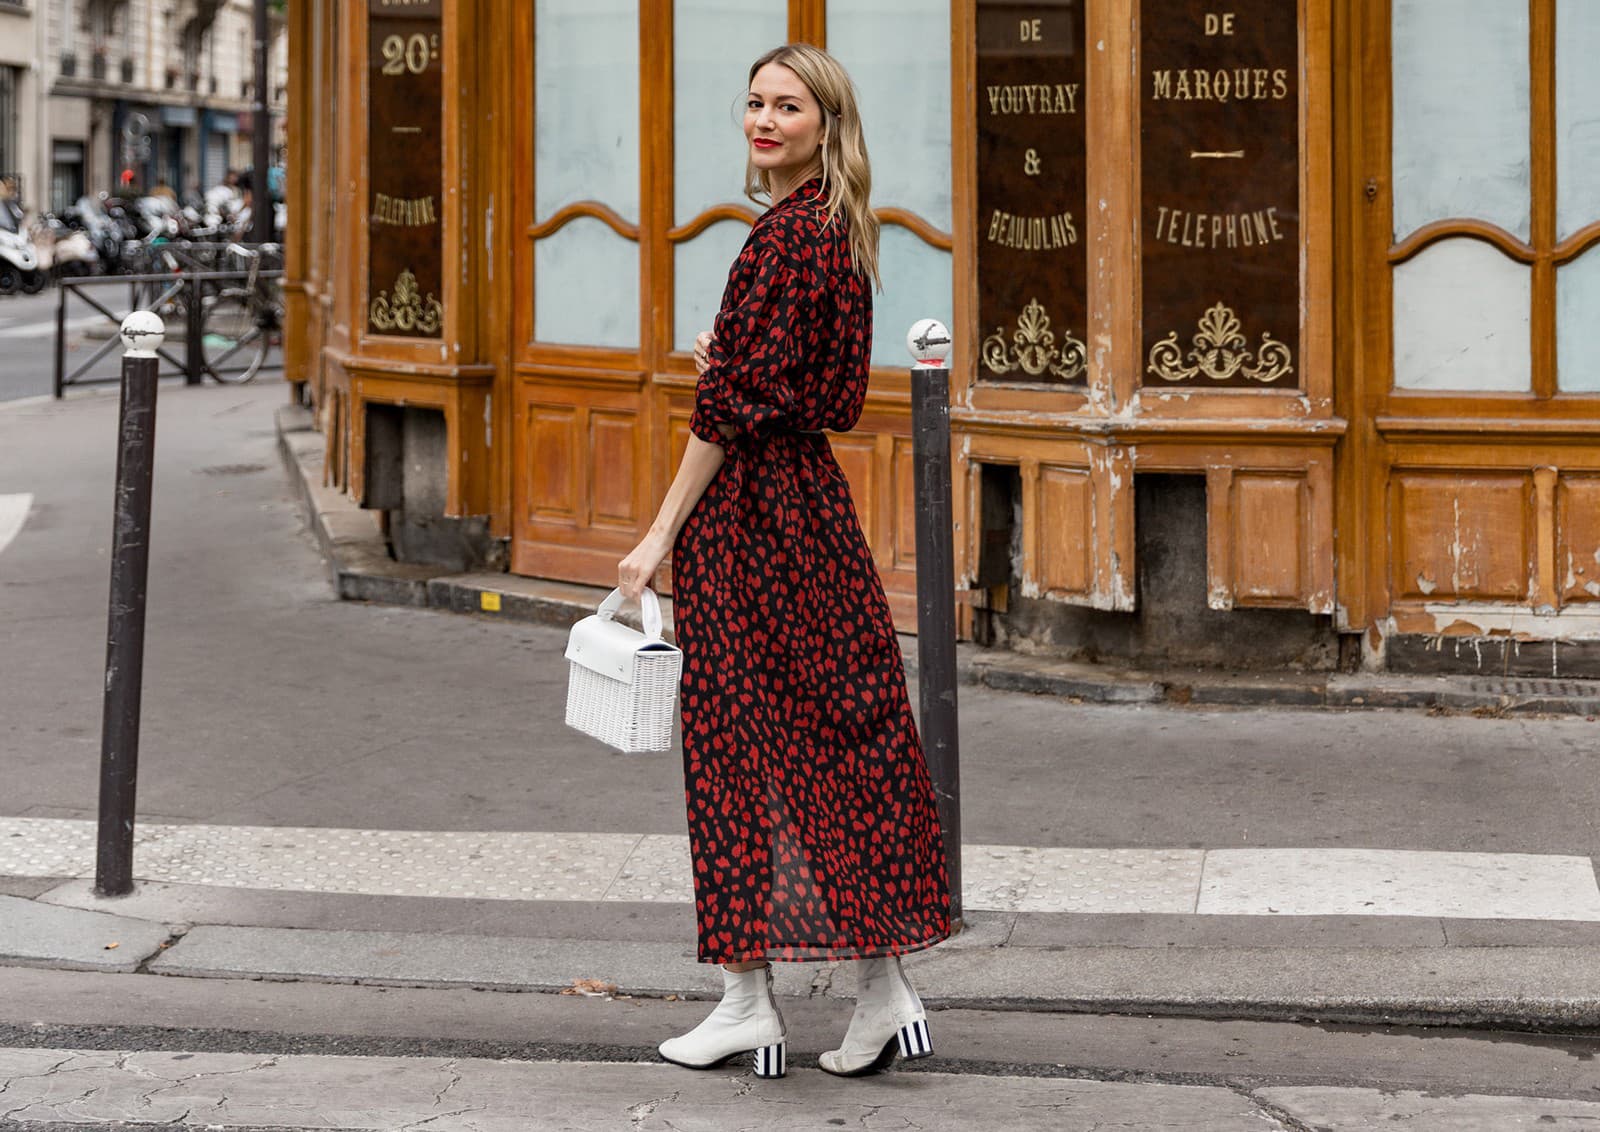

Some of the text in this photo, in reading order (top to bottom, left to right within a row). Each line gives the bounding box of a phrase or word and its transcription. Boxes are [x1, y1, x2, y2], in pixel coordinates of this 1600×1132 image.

[1020, 19, 1042, 41] DE
[1205, 13, 1235, 36] DE
[987, 83, 1080, 115] VOUVRAY
[1152, 68, 1288, 103] MARQUES
[1024, 148, 1041, 175] &
[988, 208, 1077, 250] BEAUJOLAIS
[1156, 206, 1283, 249] TELEPHONE
